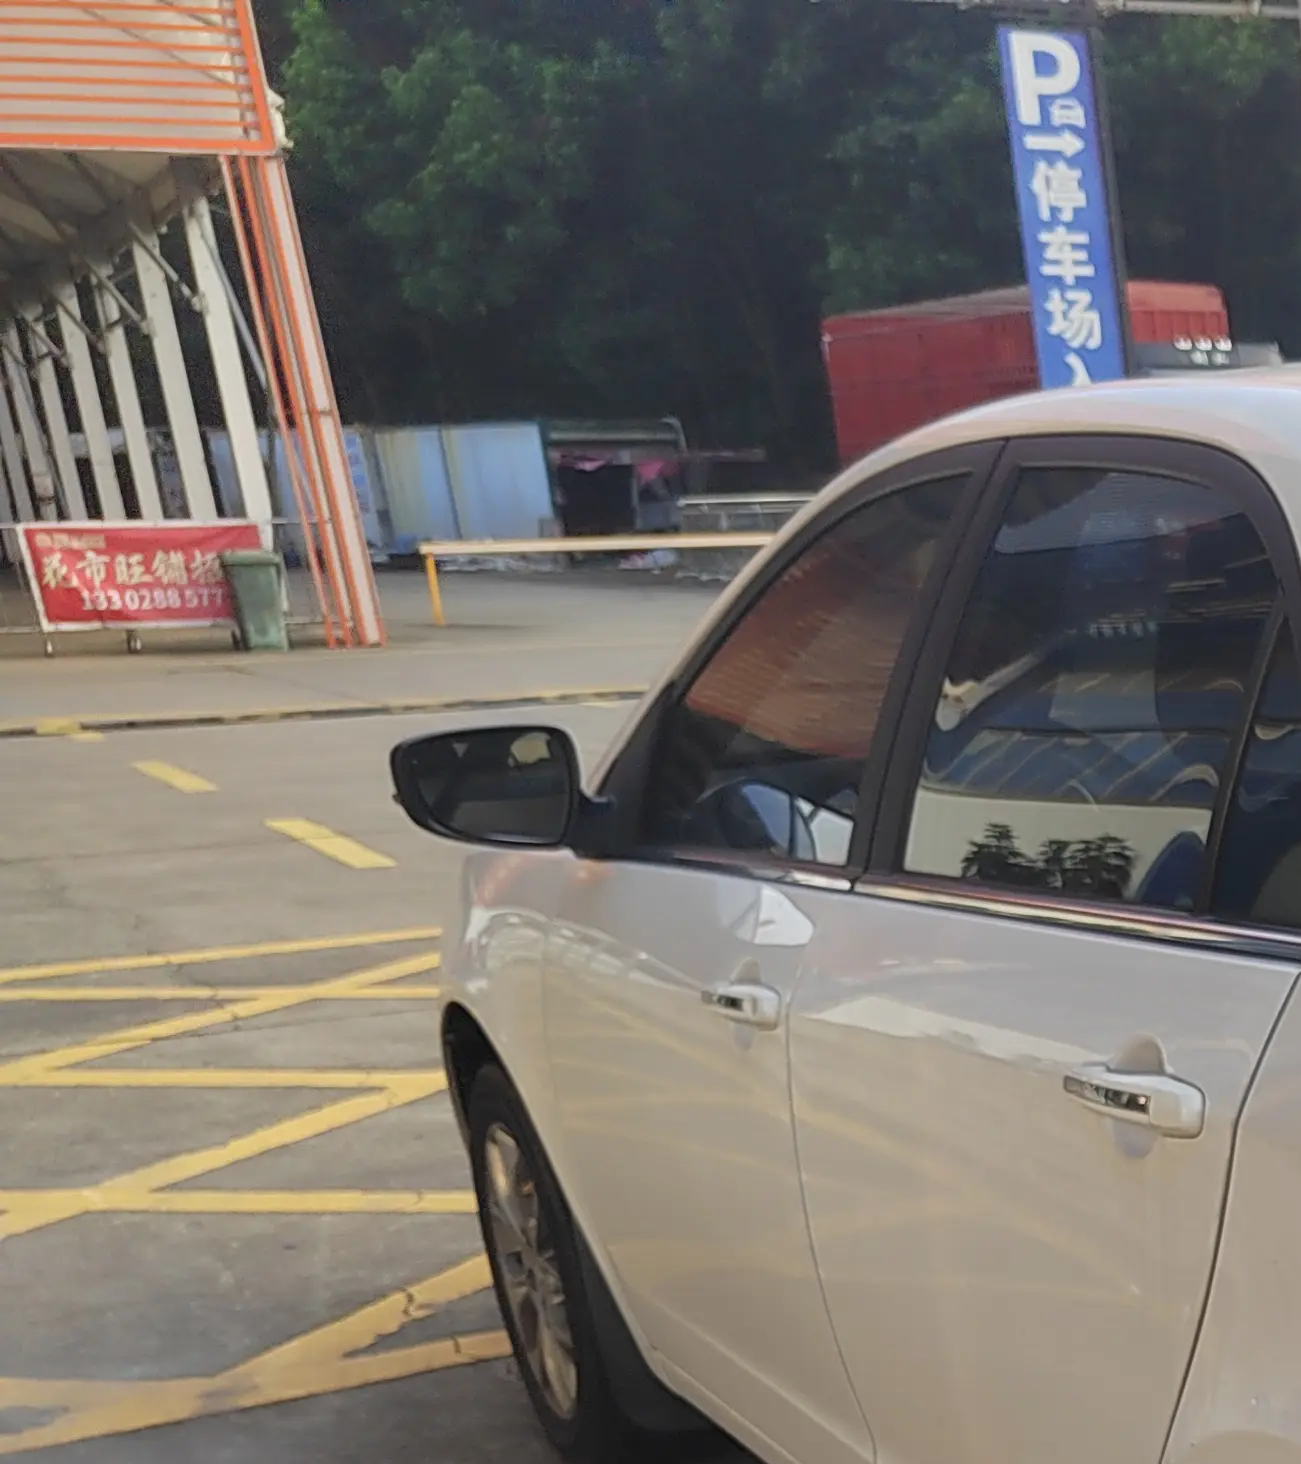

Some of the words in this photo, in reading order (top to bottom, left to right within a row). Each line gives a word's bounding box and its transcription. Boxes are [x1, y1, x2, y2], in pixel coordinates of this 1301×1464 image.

[1009, 31, 1080, 126] P
[43, 549, 235, 588] 花市旺铺招
